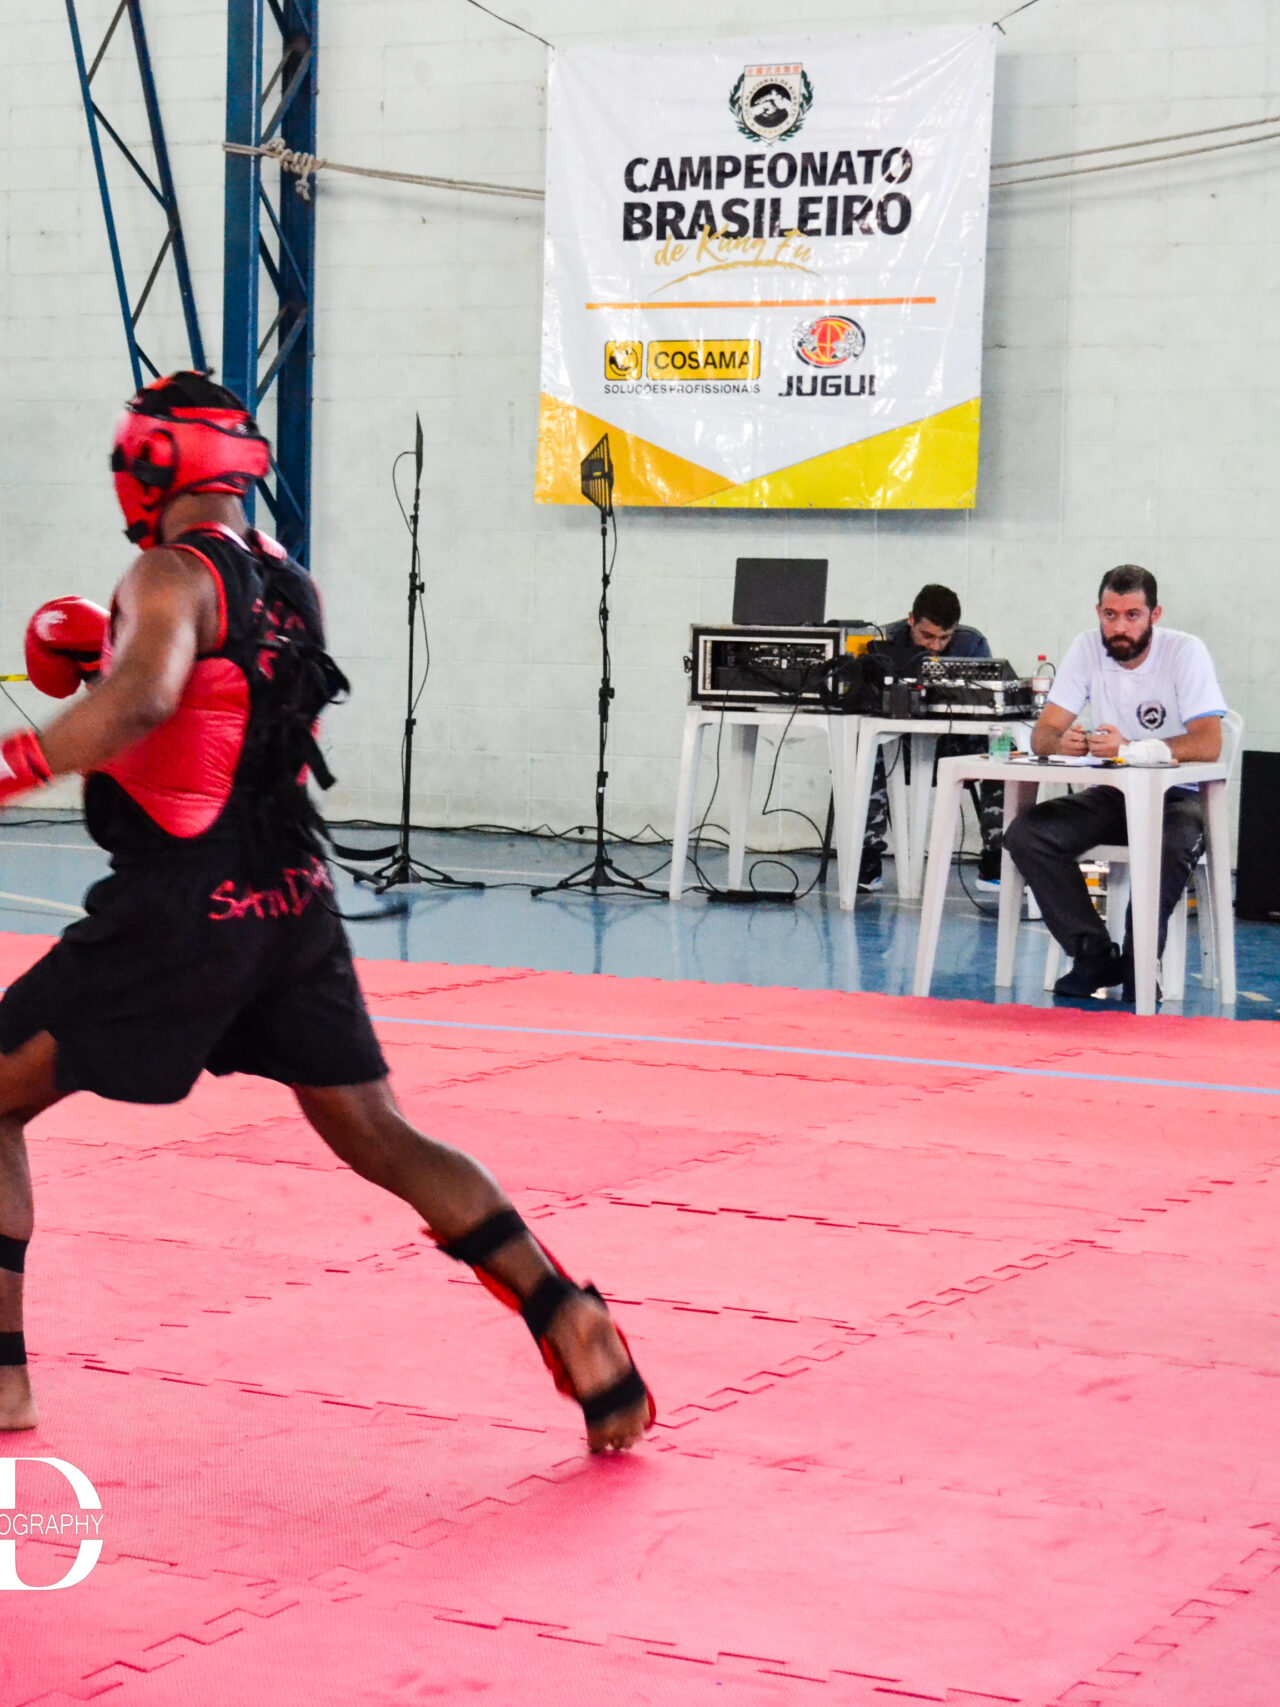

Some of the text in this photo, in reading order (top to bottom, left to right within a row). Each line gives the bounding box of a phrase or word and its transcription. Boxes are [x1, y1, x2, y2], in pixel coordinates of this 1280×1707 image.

[623, 147, 913, 193] CAMPEONATO
[622, 192, 913, 241] BRASILEIRO
[654, 223, 813, 266] de Kung Fu
[654, 350, 752, 370] COSAMA
[669, 383, 761, 395] PROFISSIONAS
[778, 374, 877, 397] JUGUI
